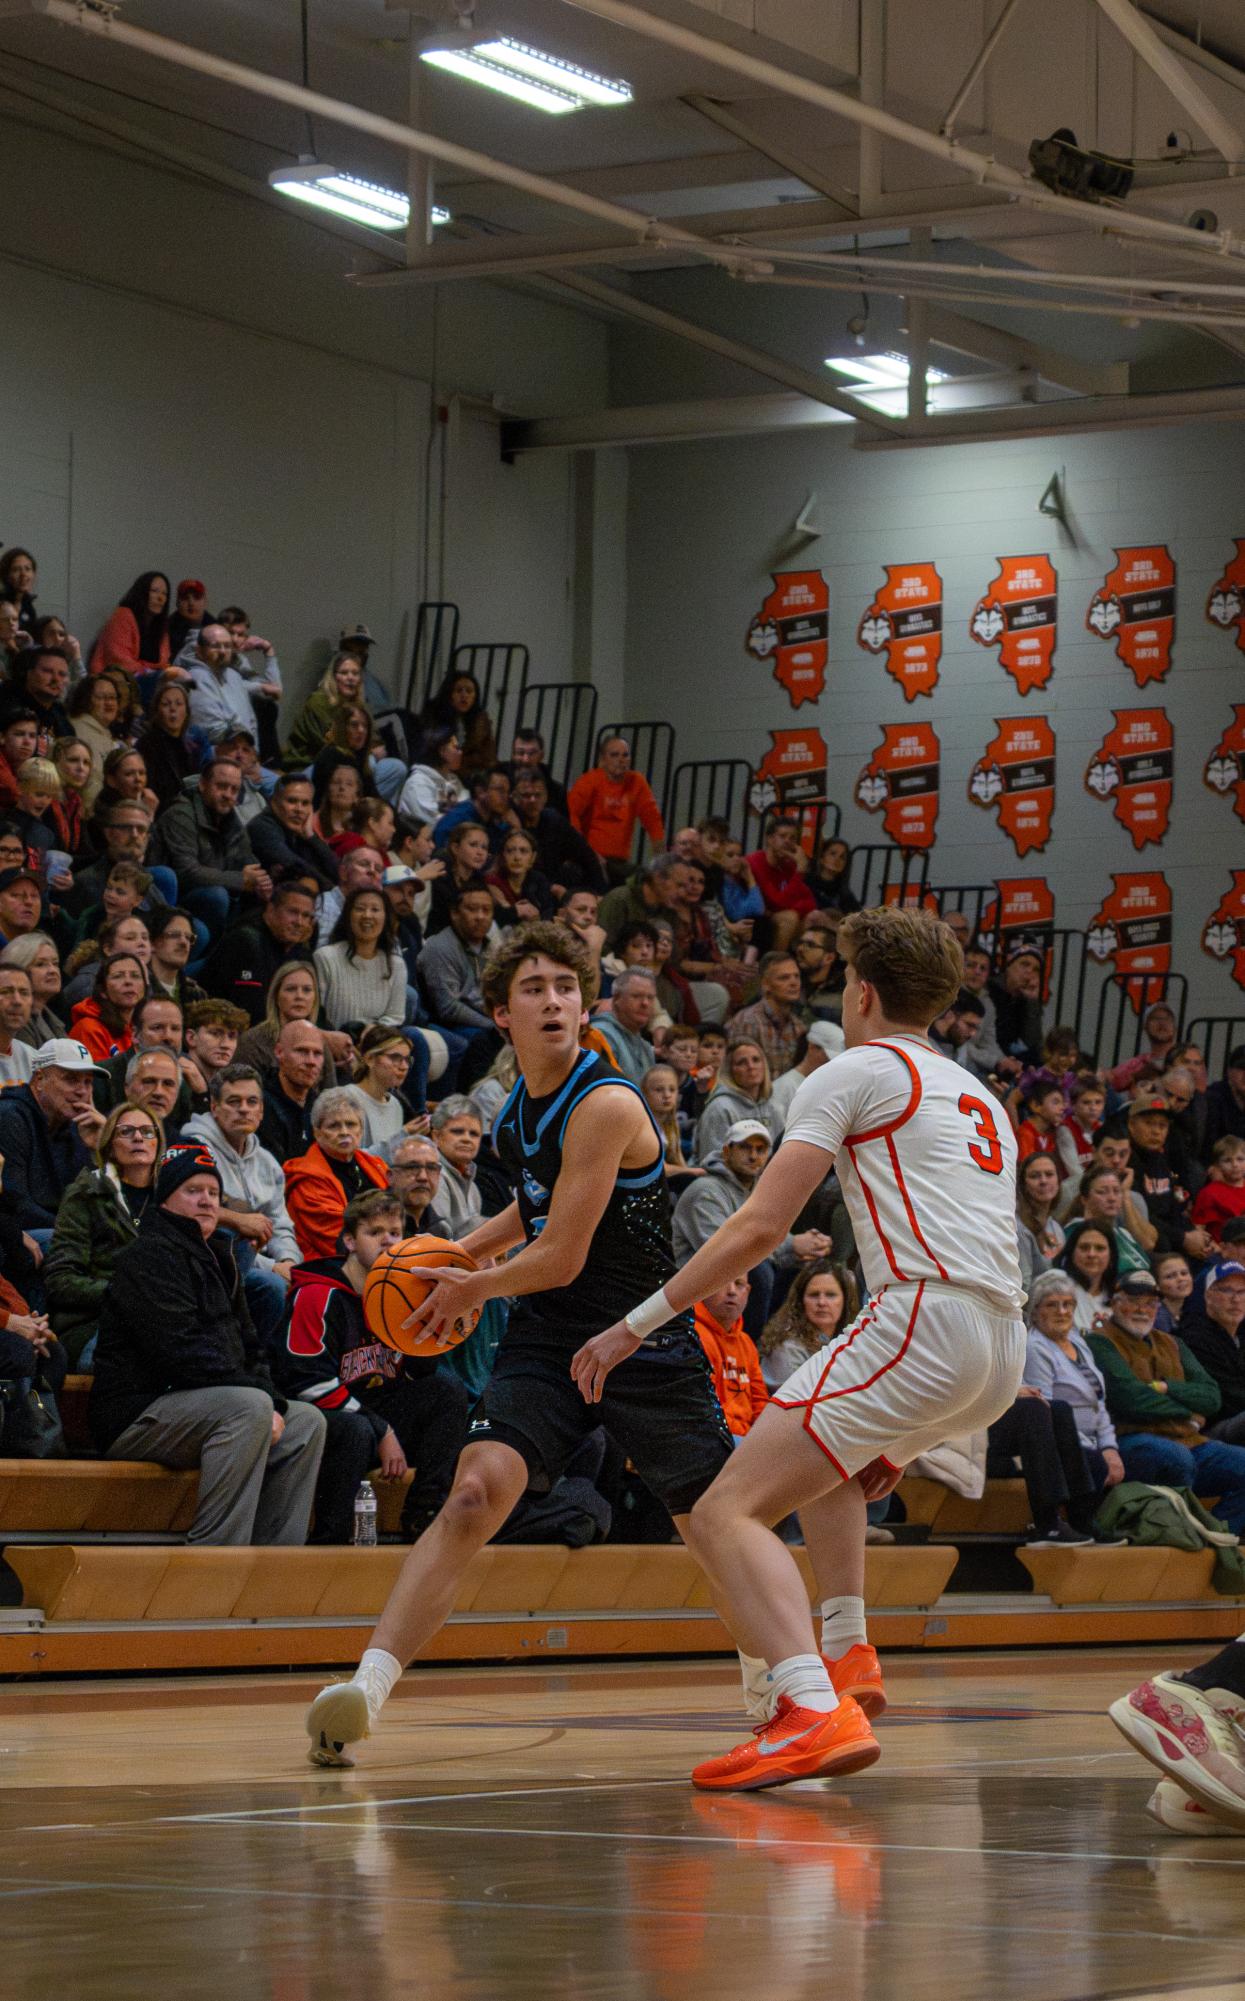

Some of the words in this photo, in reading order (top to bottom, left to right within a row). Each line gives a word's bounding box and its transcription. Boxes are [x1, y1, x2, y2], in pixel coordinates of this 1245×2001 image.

[1124, 570, 1161, 582] STATE
[1007, 578, 1043, 591] STATE
[894, 586, 928, 599] STATE
[1122, 732, 1159, 743] STATE
[891, 746, 926, 757] STATE
[1006, 740, 1041, 752] STATE
[1121, 896, 1158, 908] STATE
[78, 1045, 89, 1060] P
[958, 1092, 1003, 1176] 3
